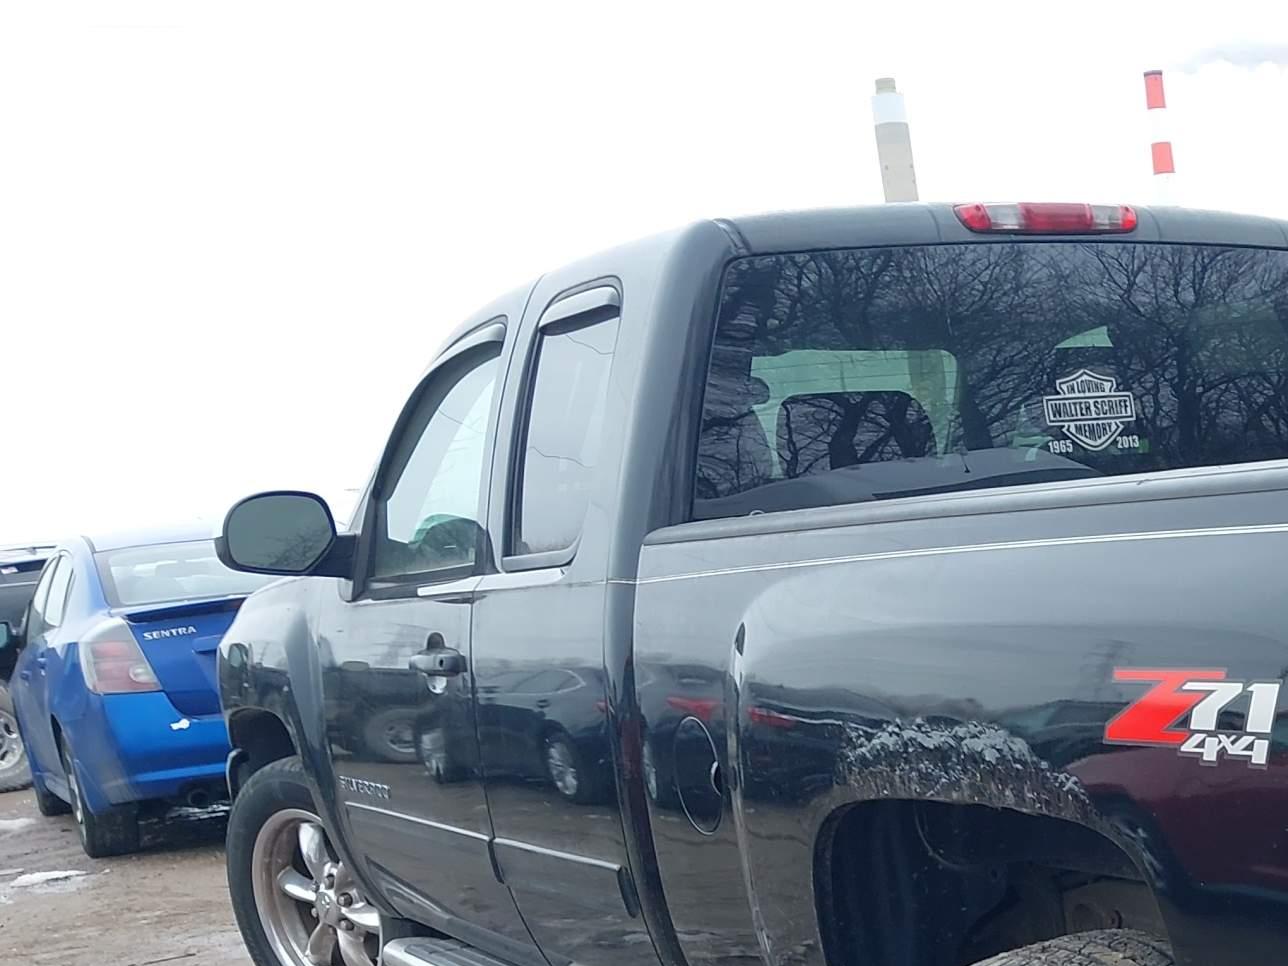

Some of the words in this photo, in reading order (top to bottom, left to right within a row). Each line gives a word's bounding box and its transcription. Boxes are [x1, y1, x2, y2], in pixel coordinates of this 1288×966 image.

[1066, 384, 1076, 395] IN
[1076, 379, 1106, 394] LOVING
[1050, 400, 1093, 418] WALTER
[1093, 398, 1129, 416] SCRIFF
[1074, 421, 1114, 441] MEMORY
[1048, 440, 1073, 453] 1965
[1116, 435, 1139, 448] 2013
[143, 626, 197, 641] SENTRA
[1105, 667, 1281, 744] Z71
